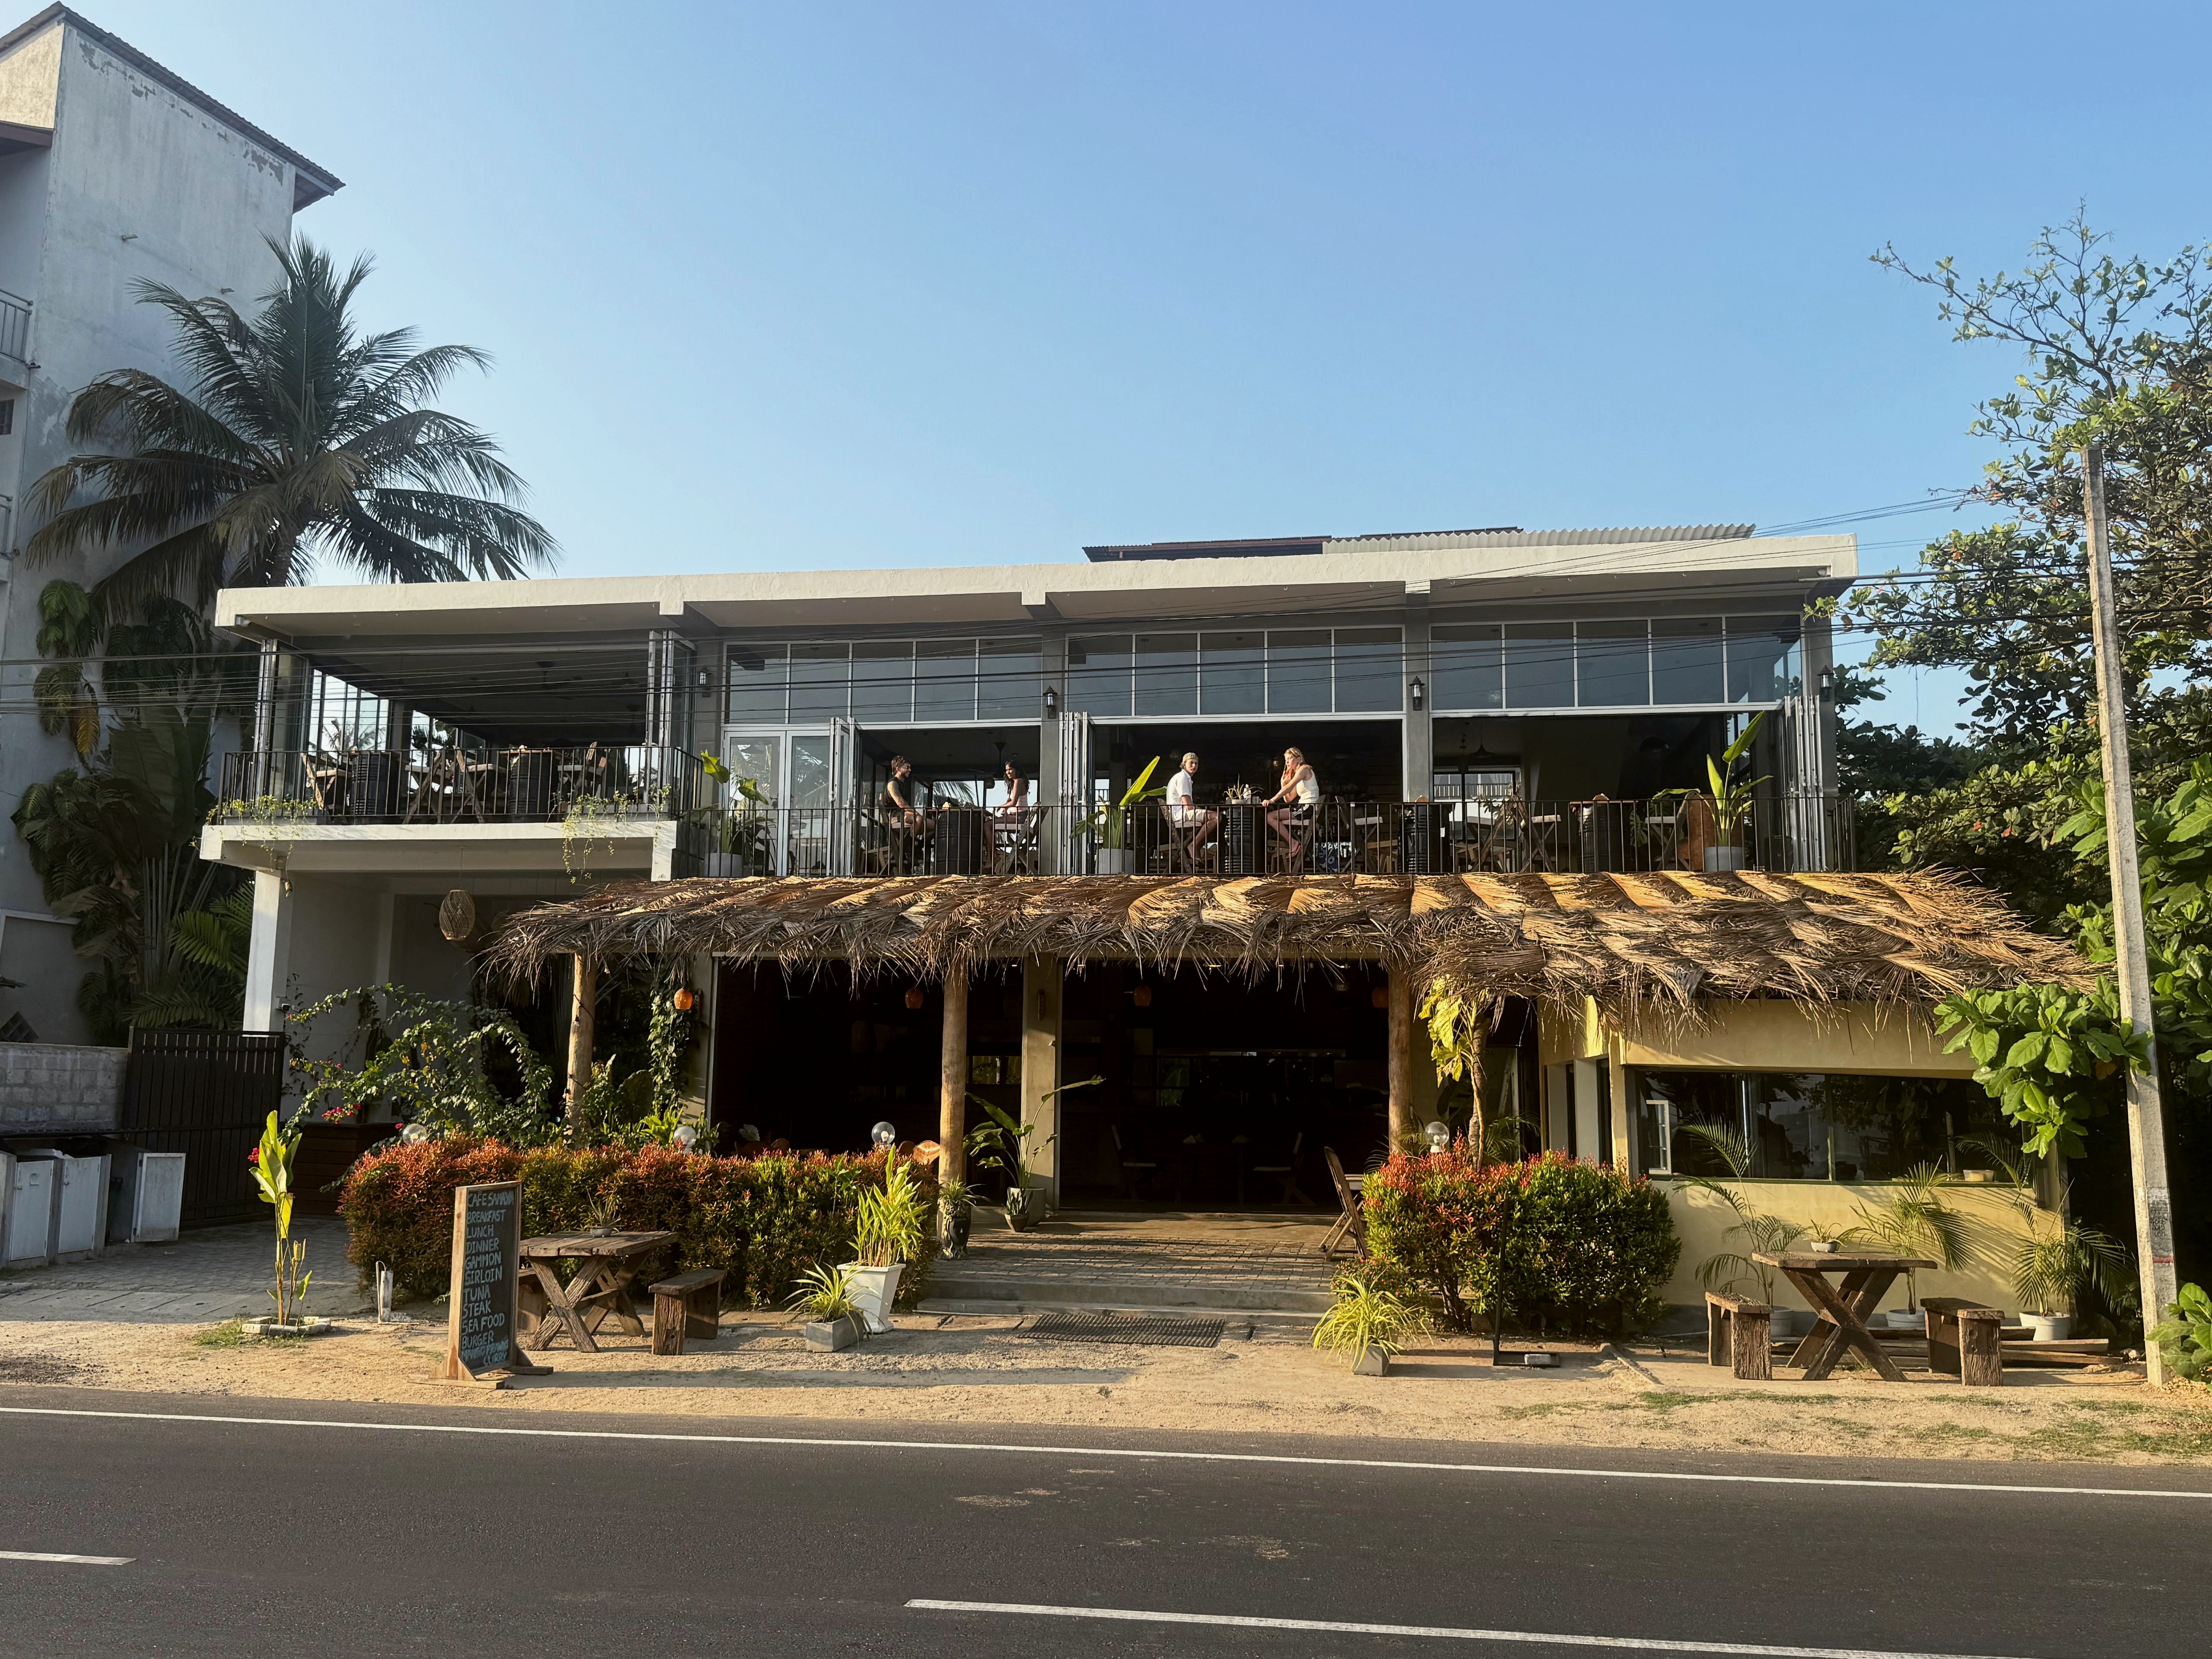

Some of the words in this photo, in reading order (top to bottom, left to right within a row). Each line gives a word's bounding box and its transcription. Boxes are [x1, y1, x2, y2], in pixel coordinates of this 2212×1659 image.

[468, 1192, 487, 1207] CAFE
[467, 1210, 506, 1224] BREAKFAST
[467, 1224, 493, 1239] LUNCH
[466, 1237, 499, 1254] DINNER
[465, 1251, 501, 1270] GAMMON
[464, 1265, 502, 1285] SIRLOIN
[463, 1284, 491, 1303] TUNA
[462, 1300, 491, 1319] STEAK
[462, 1318, 479, 1335] SEA
[481, 1313, 505, 1331] FOOD
[462, 1330, 494, 1349] BURGER
[483, 1351, 507, 1366] CURRY
